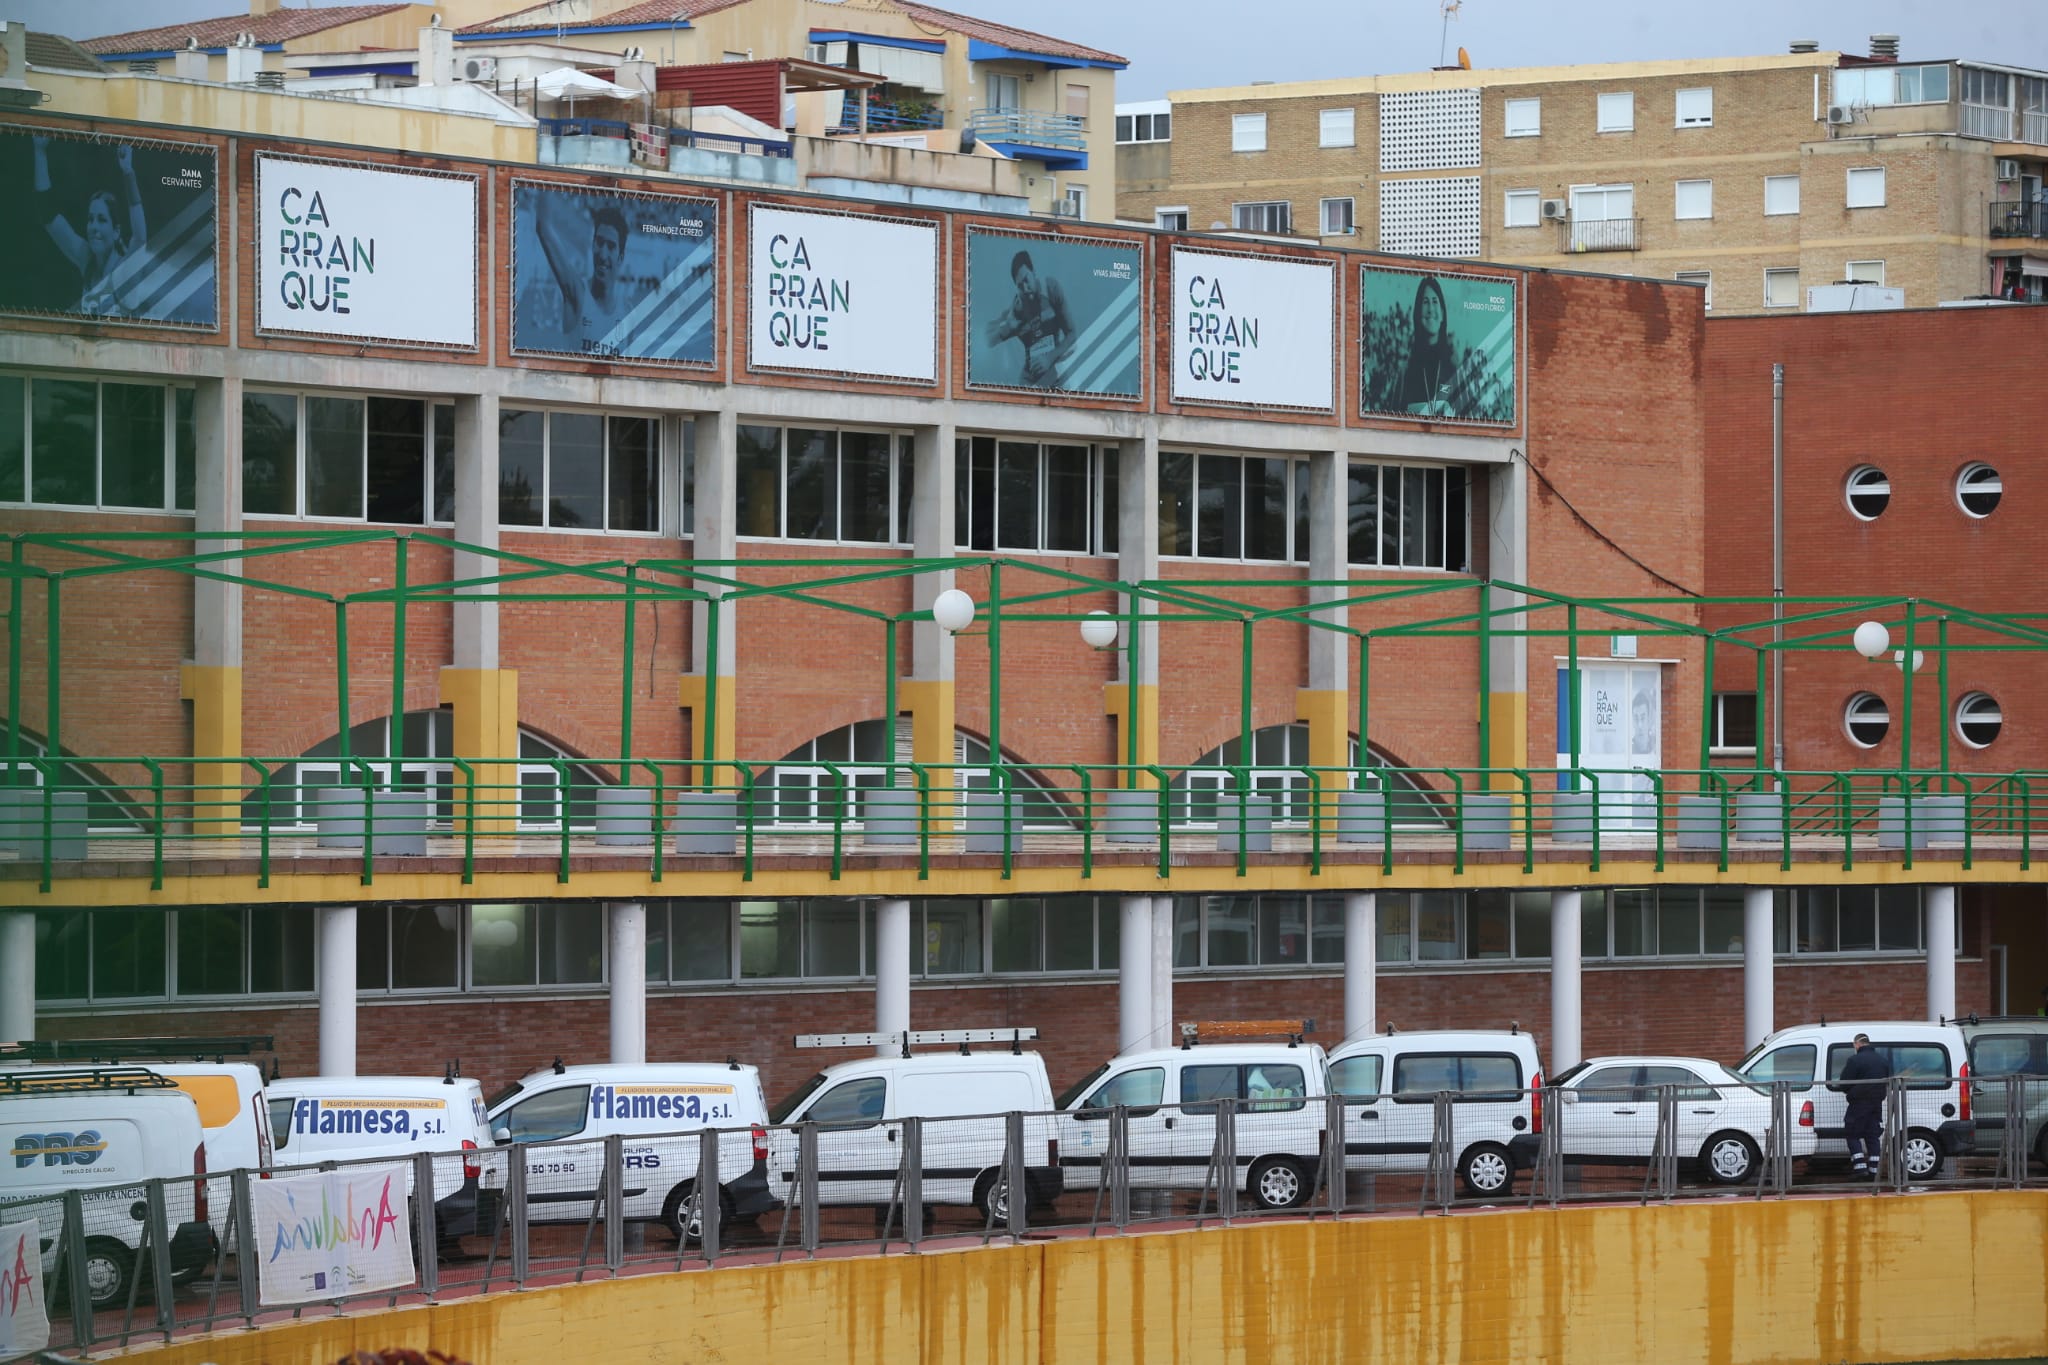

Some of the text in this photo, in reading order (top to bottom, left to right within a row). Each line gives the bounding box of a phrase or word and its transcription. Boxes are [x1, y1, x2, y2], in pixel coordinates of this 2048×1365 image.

[161, 176, 202, 188] CERVANTES
[181, 169, 202, 178] DANA
[281, 187, 329, 228] CA
[680, 217, 703, 227] ÁLVARO
[642, 224, 703, 237] FERNÁNDEZ CEREZO
[281, 229, 374, 274] RRAN
[769, 234, 811, 271] CA
[1113, 262, 1131, 271] BORJA
[281, 271, 350, 314] QUE
[769, 272, 849, 313] RRAN
[1189, 275, 1225, 310] CA
[769, 311, 828, 350] QUE
[1189, 311, 1258, 349] RRAN
[1189, 347, 1240, 384] QUE
[1596, 690, 1608, 701] CA
[1596, 702, 1618, 713] RRAN
[1596, 713, 1613, 725] QUE
[294, 1100, 445, 1140] flamesa, s.l.
[591, 1086, 733, 1123] flamesa, s.l.
[14, 1130, 103, 1168] PRS
[622, 1155, 660, 1168] RS
[532, 1164, 544, 1174] 50
[547, 1164, 560, 1173] 70
[563, 1163, 575, 1172] 90
